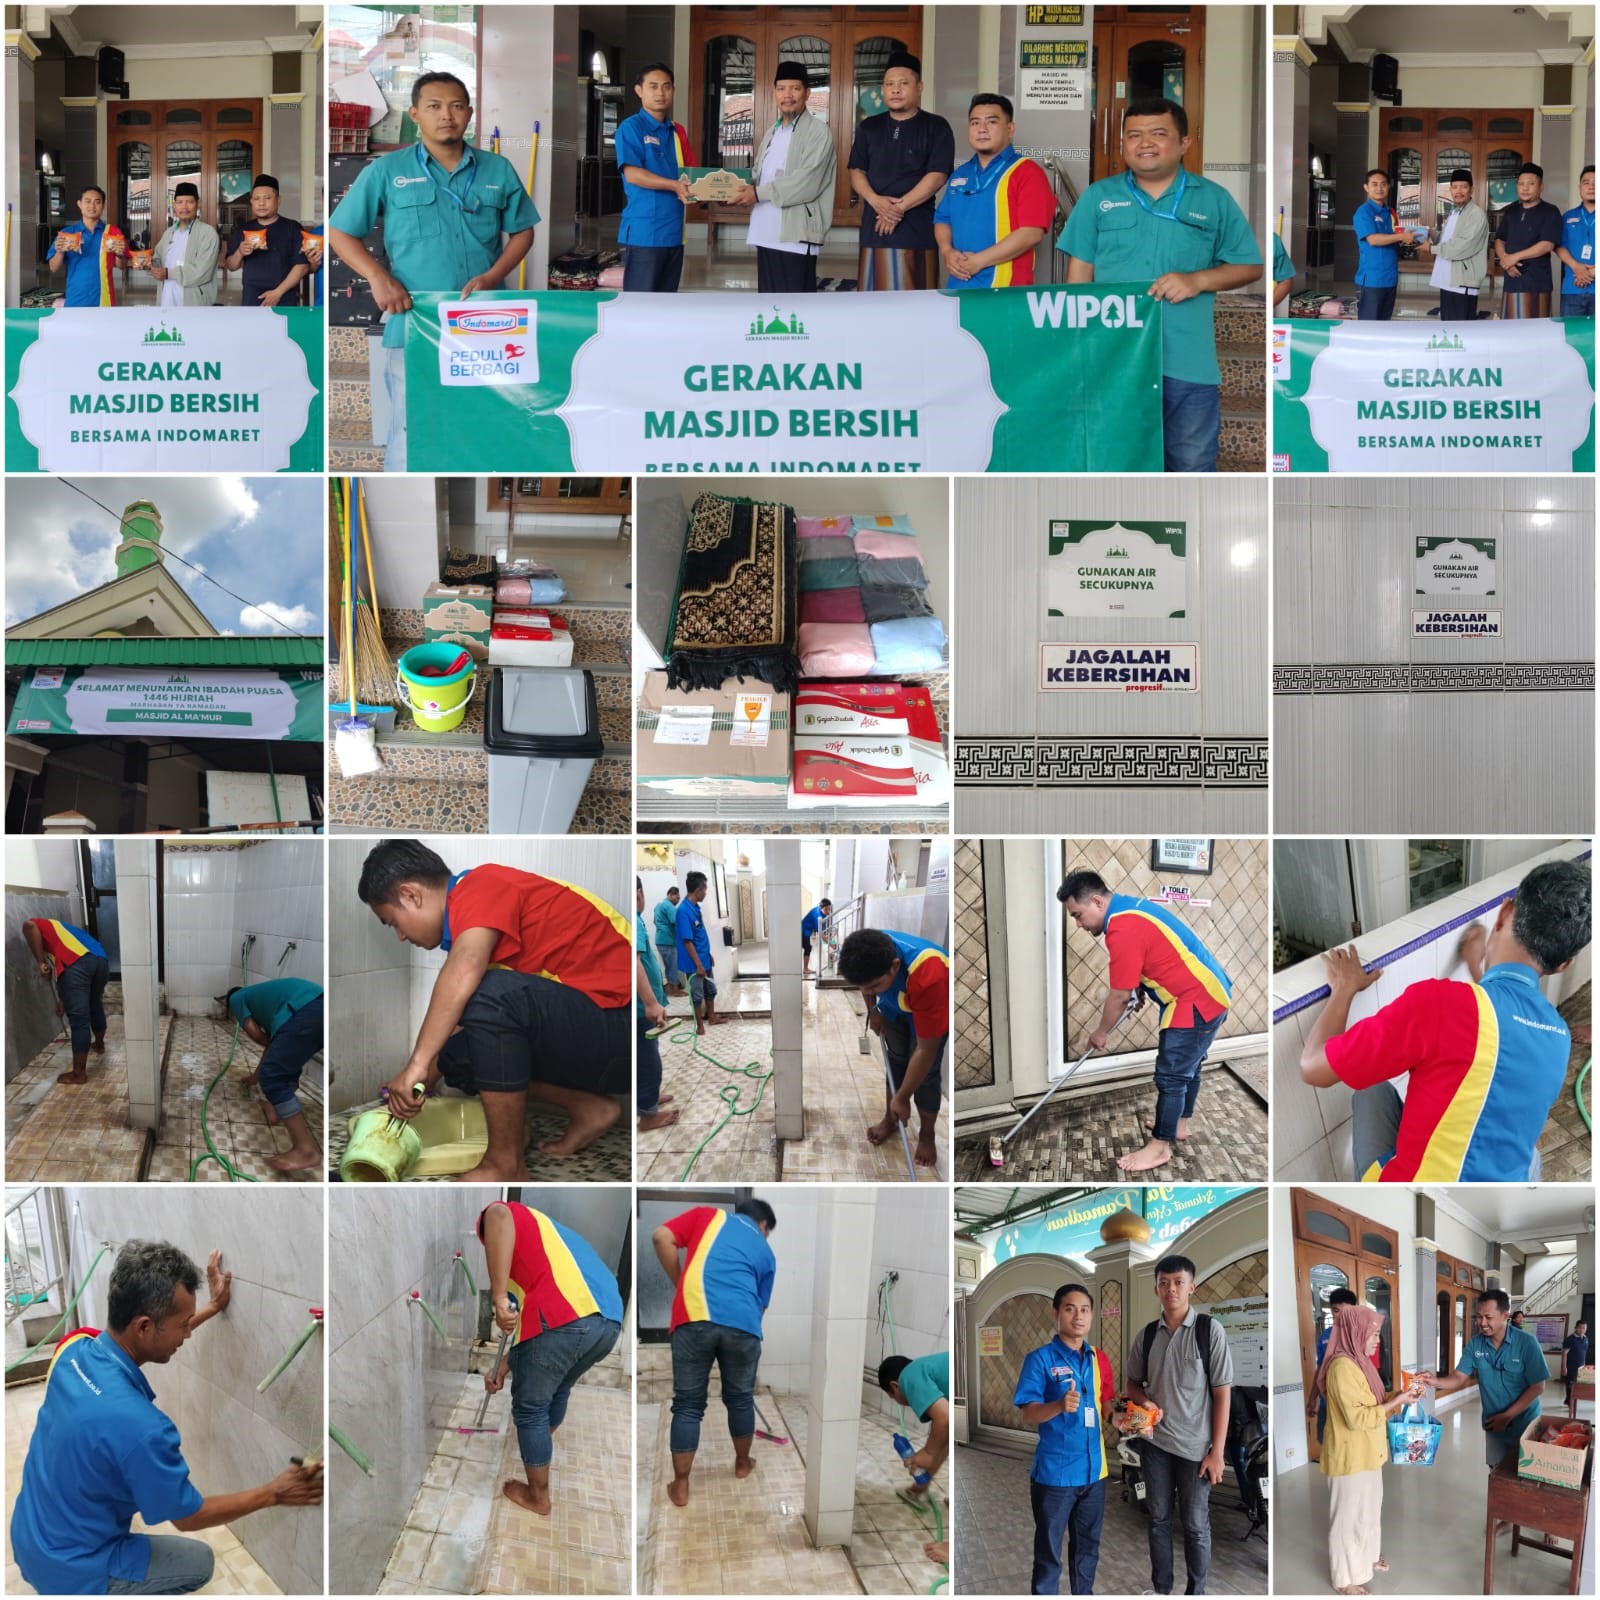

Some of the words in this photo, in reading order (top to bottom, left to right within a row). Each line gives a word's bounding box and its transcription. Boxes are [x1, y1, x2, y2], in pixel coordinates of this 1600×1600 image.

[1024, 43, 1054, 53] DILARANG
[1055, 43, 1086, 53] MEROKOK
[1030, 54, 1037, 64] DI
[1038, 54, 1054, 64] AREA
[1055, 54, 1078, 65] MASJID
[1026, 291, 1144, 328] WIPOL
[462, 318, 514, 329] Indomaret
[450, 350, 503, 363] PEDULI
[98, 361, 222, 381] GERAKAN
[450, 362, 520, 377] BERBAGI
[684, 362, 862, 393] GERAKAN
[1384, 367, 1503, 388] GERAKAN
[70, 394, 164, 414] MASJID
[170, 393, 259, 413] BERSIH
[1357, 400, 1447, 419] MASJID
[1453, 400, 1541, 419] BERSIH
[644, 409, 779, 439] MASJID
[789, 409, 918, 437] BERSIH
[70, 430, 151, 443] BERSAMA
[157, 429, 260, 442] INDOMARET
[1358, 435, 1435, 448] BERSAMA
[1441, 435, 1543, 448] INDOMARET
[1077, 567, 1135, 577] GUNAKAN
[1137, 567, 1156, 577] AIR
[1079, 580, 1155, 590] SECUKUPNYA
[1427, 613, 1487, 622] JAGALAH
[1416, 624, 1498, 633] KEBERSIHAN
[1066, 649, 1171, 664] JAGALAH
[1047, 668, 1190, 682] KEBERSIHAN
[77, 684, 125, 692] SELAMAT
[126, 684, 200, 694] MENUNAIKAN
[203, 686, 244, 694] IBADAH
[247, 686, 284, 695] PUASA
[1125, 684, 1163, 692] progresif
[171, 694, 214, 702] HIJRIAH
[184, 713, 223, 721] MA'MUR
[1169, 886, 1189, 894] TOILET
[1535, 1459, 1578, 1475] Amanah
